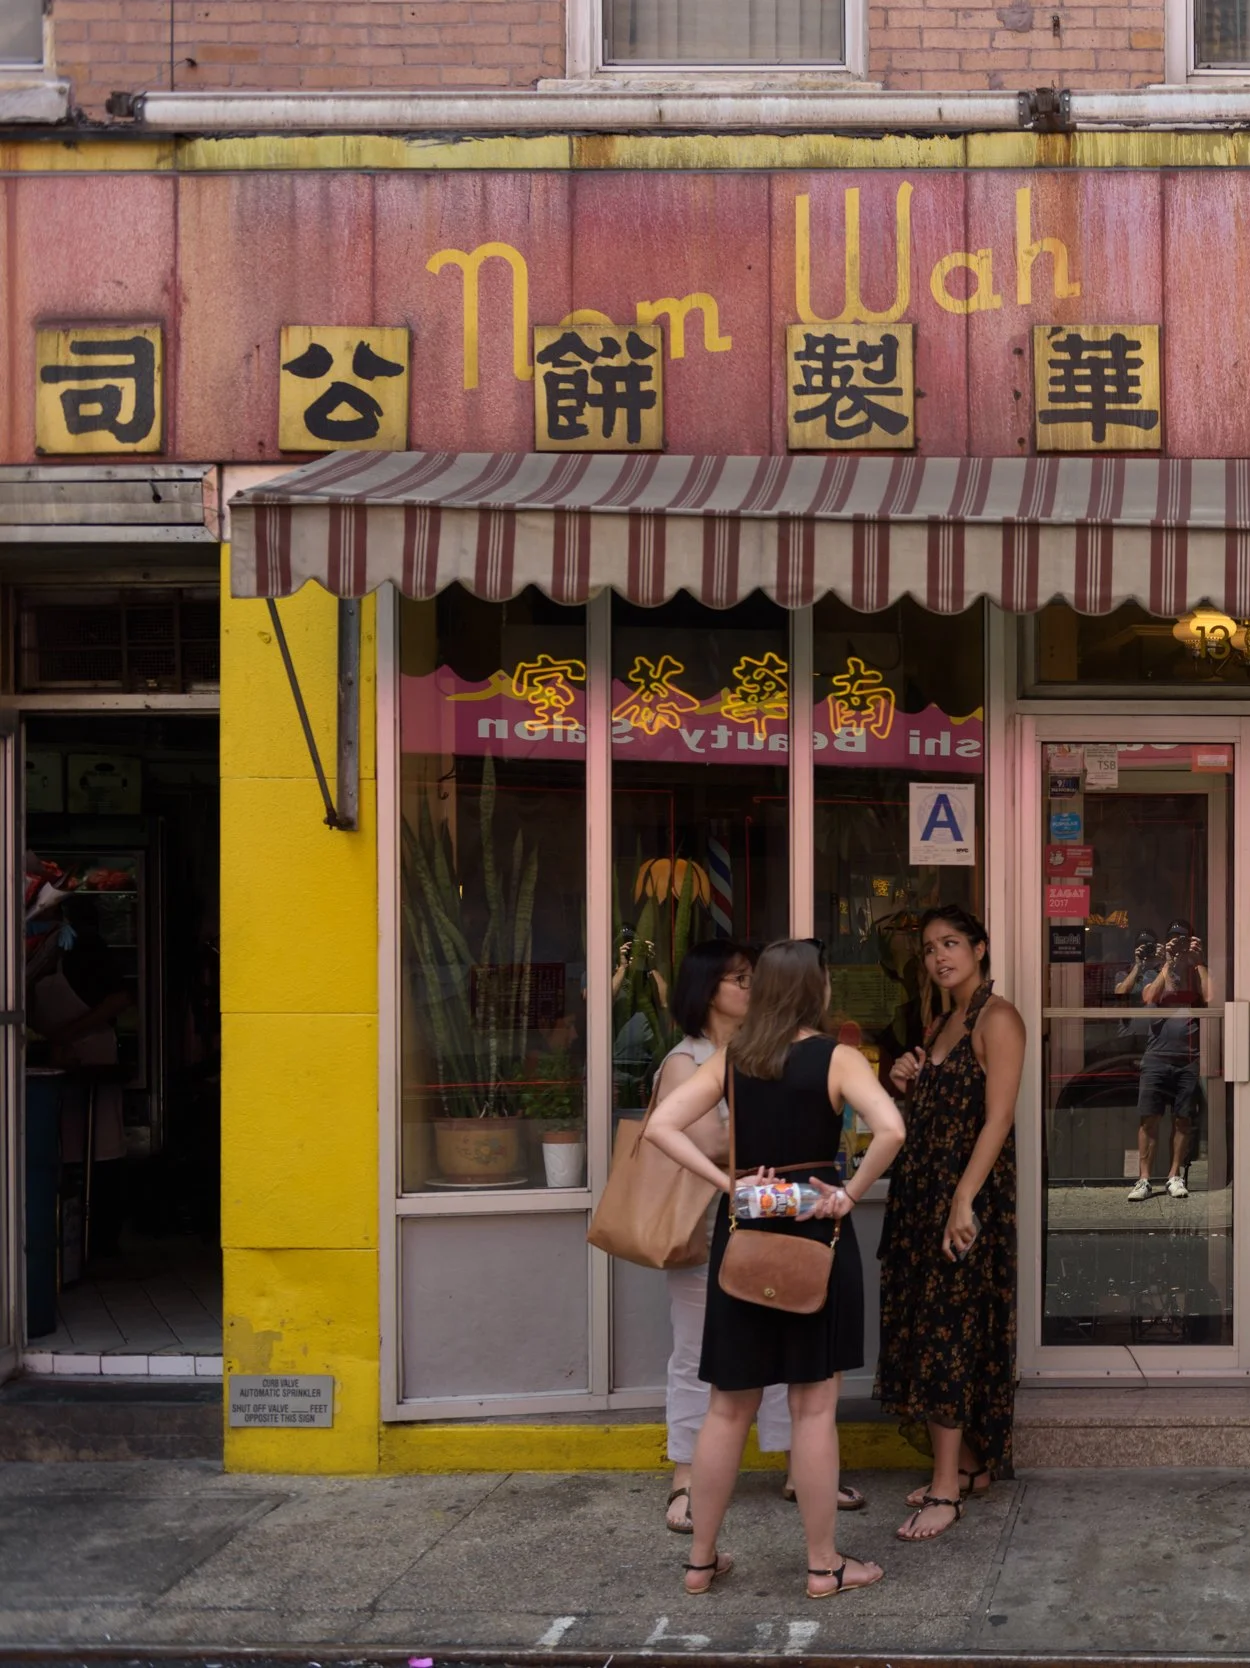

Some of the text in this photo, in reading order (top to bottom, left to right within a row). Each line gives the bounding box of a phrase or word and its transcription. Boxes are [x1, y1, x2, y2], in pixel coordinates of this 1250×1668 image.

[425, 241, 732, 390] Nm
[795, 180, 1081, 324] Wah
[1196, 625, 1231, 659] 13
[920, 793, 964, 842] A
[1049, 889, 1085, 898] ZAGAT
[1049, 899, 1069, 908] 2017
[280, 1379, 299, 1387] VALVE
[240, 1389, 322, 1398] AUTOMATIC SPRINKLER
[232, 1404, 328, 1413] SHUT OFF VALVE FEET
[244, 1413, 316, 1423] OPPOSITE THIS SIGN
